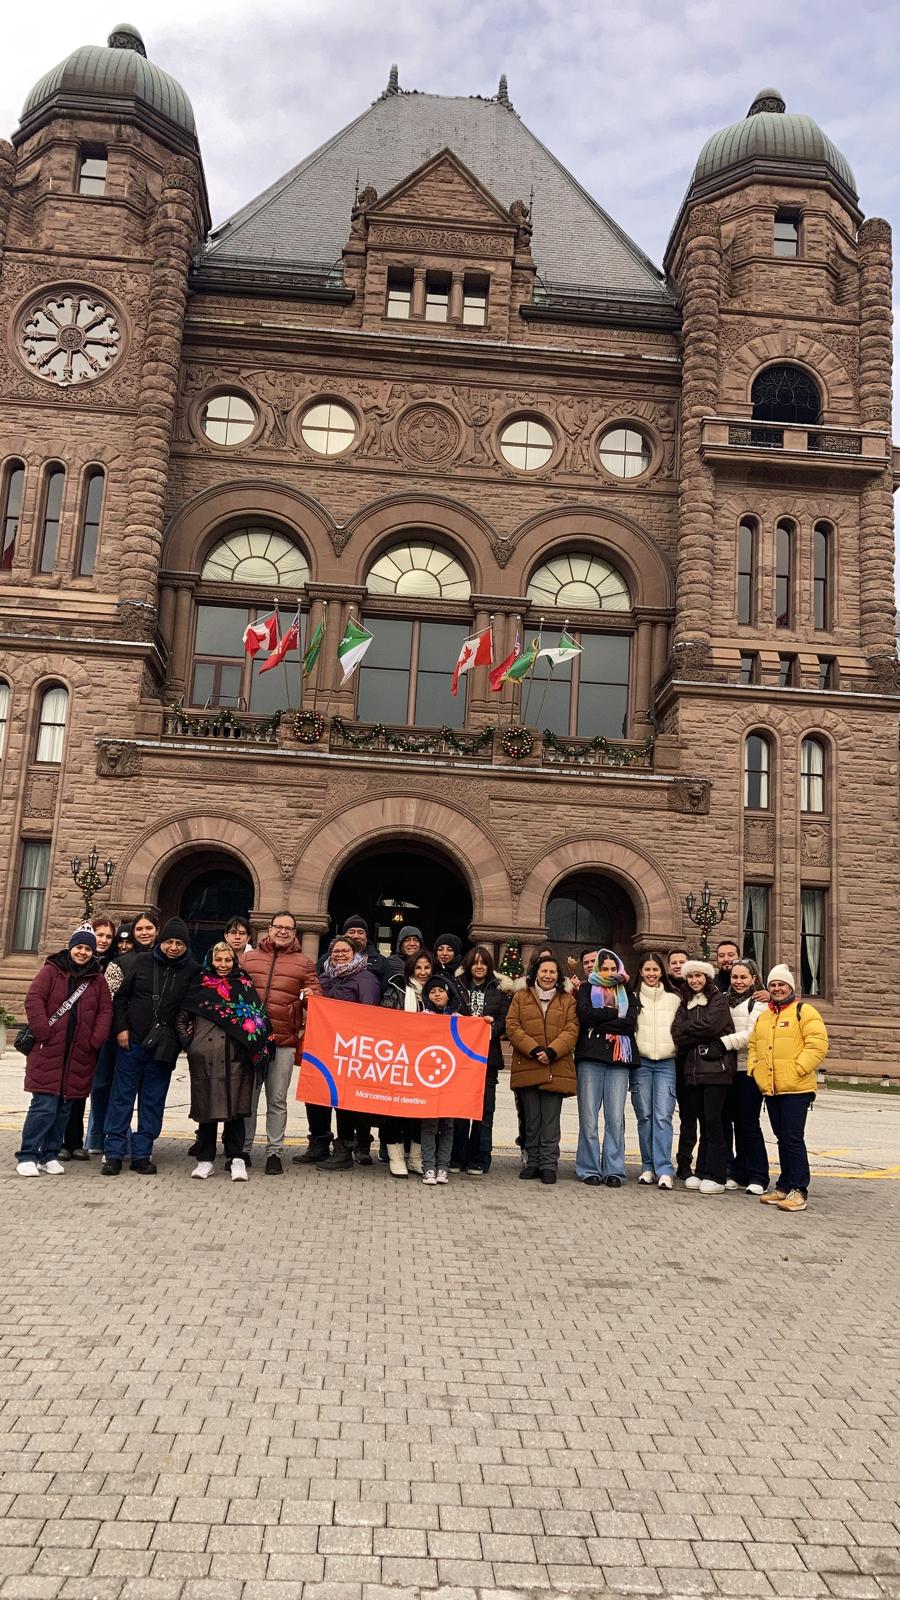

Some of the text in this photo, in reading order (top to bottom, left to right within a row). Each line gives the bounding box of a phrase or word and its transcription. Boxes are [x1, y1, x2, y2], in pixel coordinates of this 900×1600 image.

[334, 1032, 410, 1065] MEGA
[333, 1055, 414, 1087] TRAVEL
[355, 1090, 393, 1102] Marcamos
[400, 1095, 427, 1105] destino
